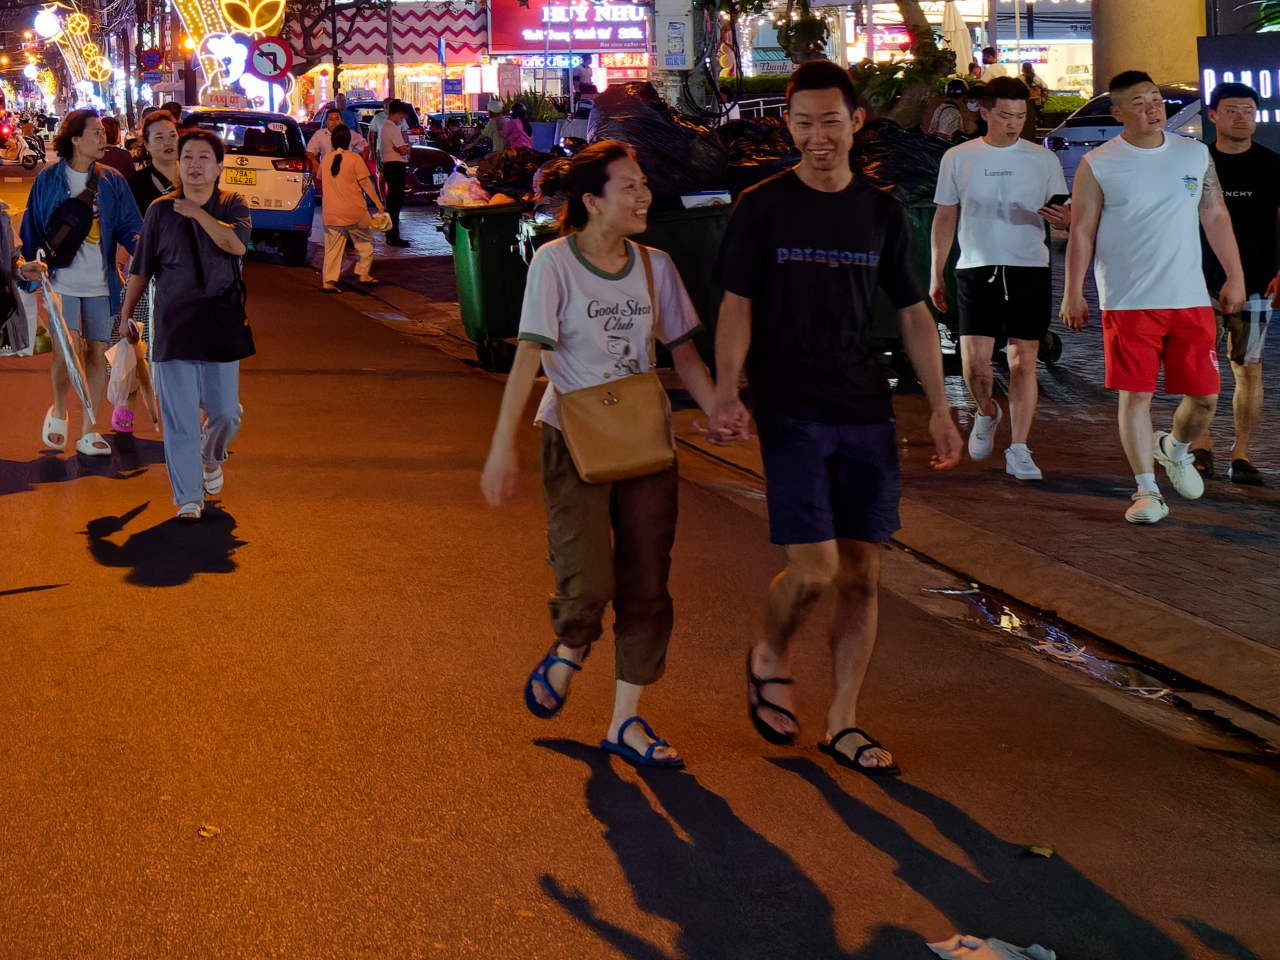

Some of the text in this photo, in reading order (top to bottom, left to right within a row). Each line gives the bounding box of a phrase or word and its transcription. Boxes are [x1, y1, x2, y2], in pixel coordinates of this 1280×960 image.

[209, 95, 227, 104] TAXI
[586, 300, 619, 319] Good
[603, 316, 635, 332] Club
